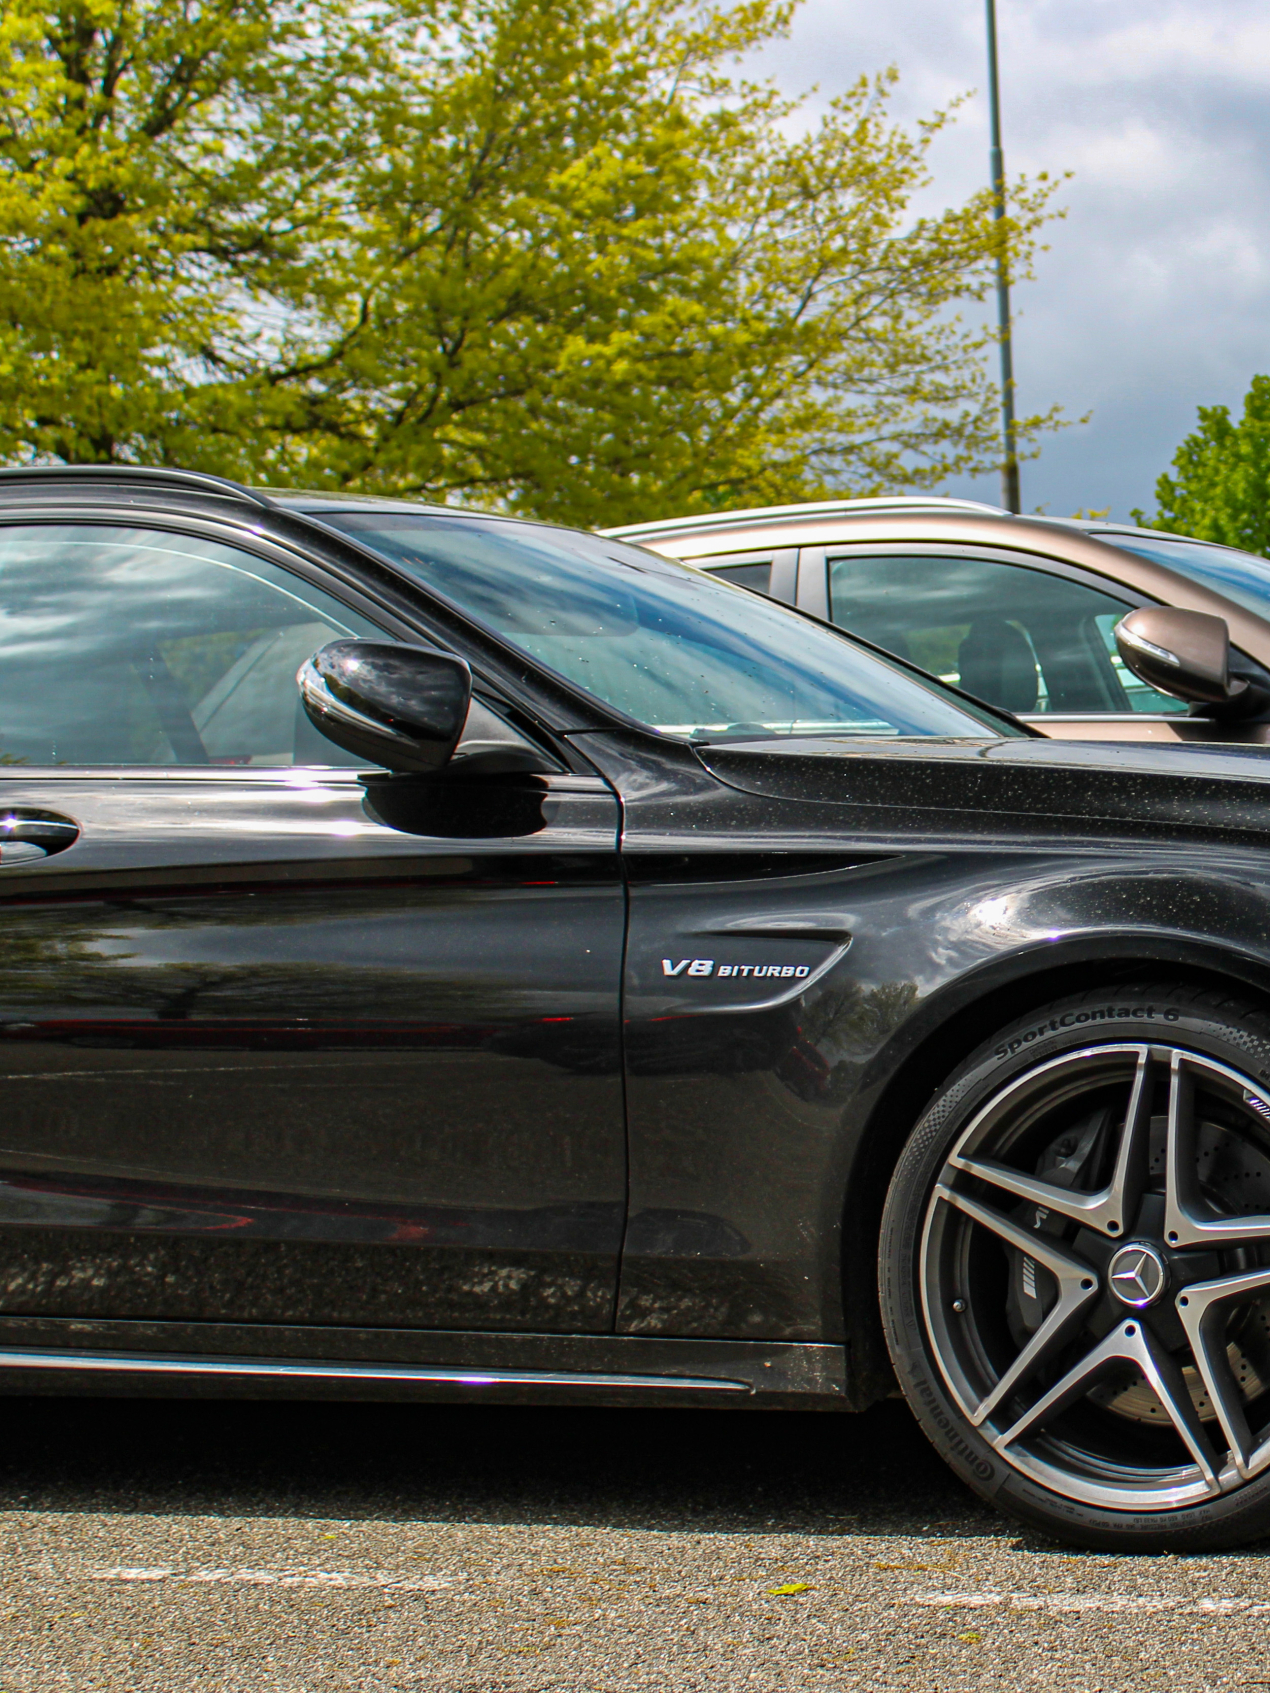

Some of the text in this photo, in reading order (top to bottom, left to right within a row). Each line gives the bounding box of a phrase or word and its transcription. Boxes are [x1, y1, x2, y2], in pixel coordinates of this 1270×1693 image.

[662, 958, 811, 978] V8 BITURBO
[993, 1003, 1156, 1061] SportContact
[1162, 1005, 1180, 1022] 6
[913, 1378, 996, 1482] Continental
